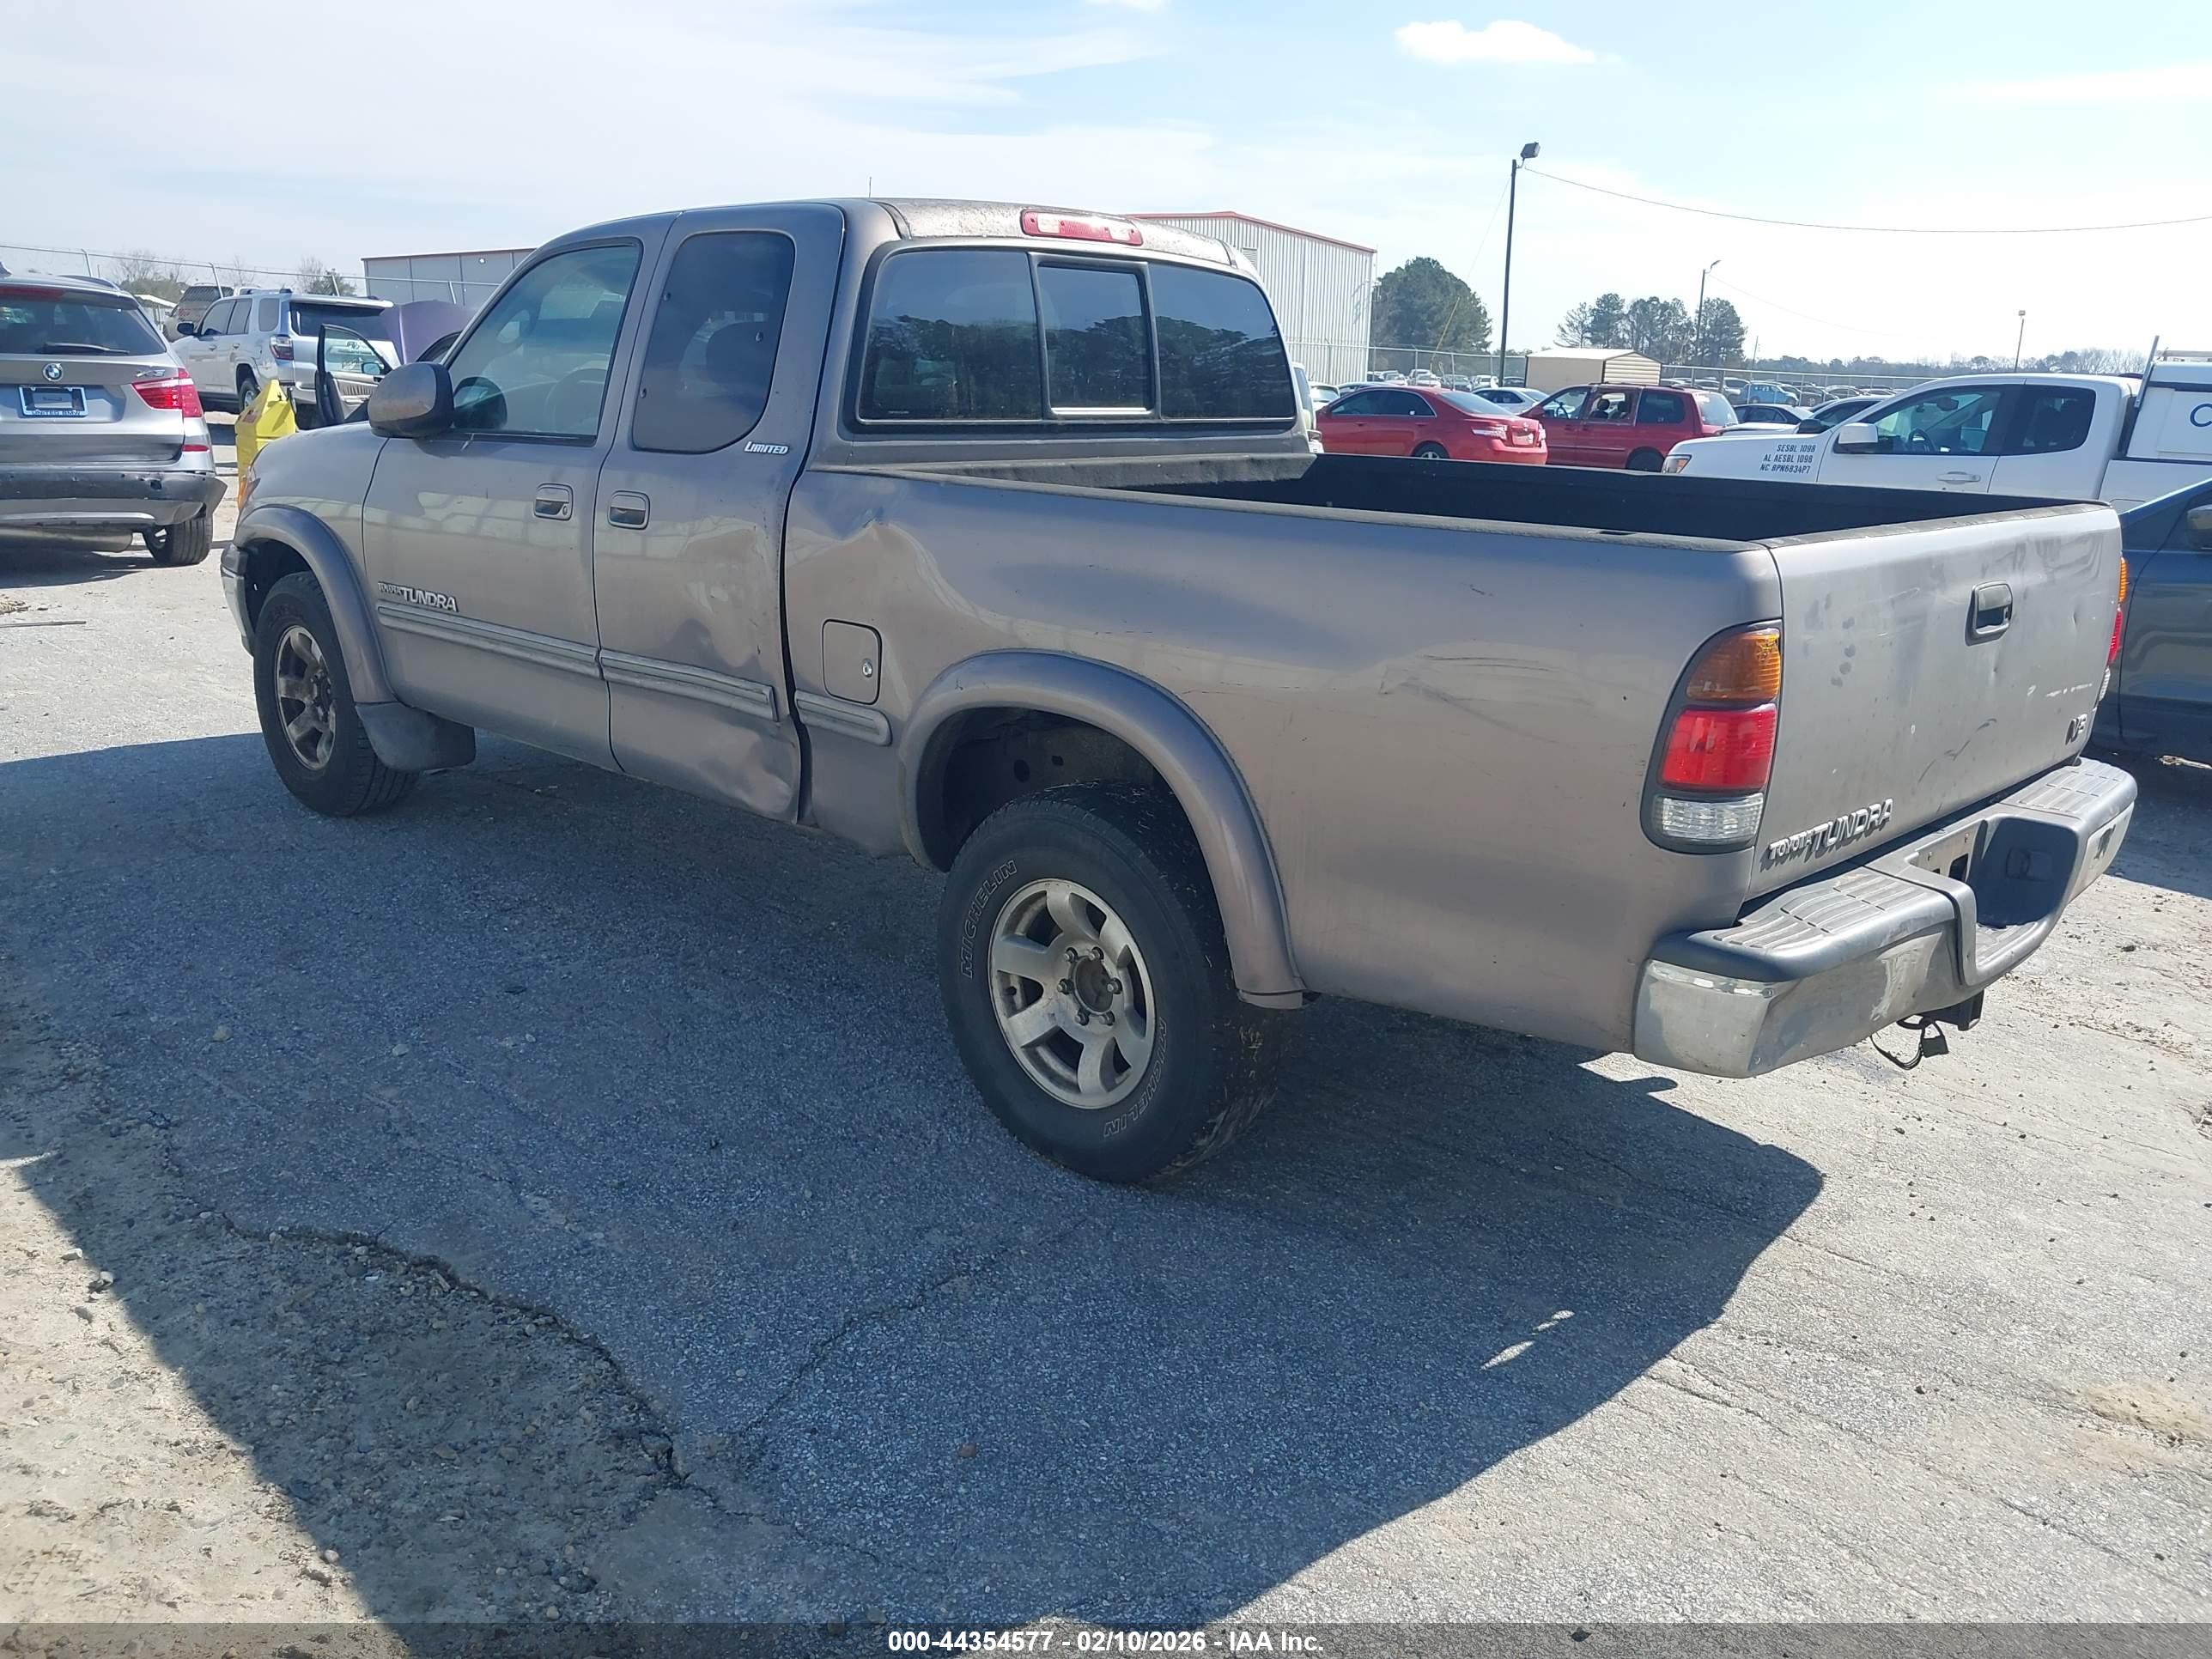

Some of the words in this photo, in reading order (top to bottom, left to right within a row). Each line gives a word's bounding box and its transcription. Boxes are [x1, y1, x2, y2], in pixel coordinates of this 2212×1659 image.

[744, 441, 789, 455] LIMITED
[1763, 453, 1771, 462] AL
[1773, 454, 1795, 463] AESBL
[1797, 455, 1814, 464] 1098
[1777, 444, 1797, 453] SESBL
[1800, 444, 1817, 453] 1098
[401, 586, 459, 612] TUNDRA
[1769, 830, 1813, 860] TOYOTA
[1813, 798, 1894, 852] TUNDRA
[960, 860, 1018, 978] MICHELIN
[1103, 1016, 1169, 1138] MICHELIN
